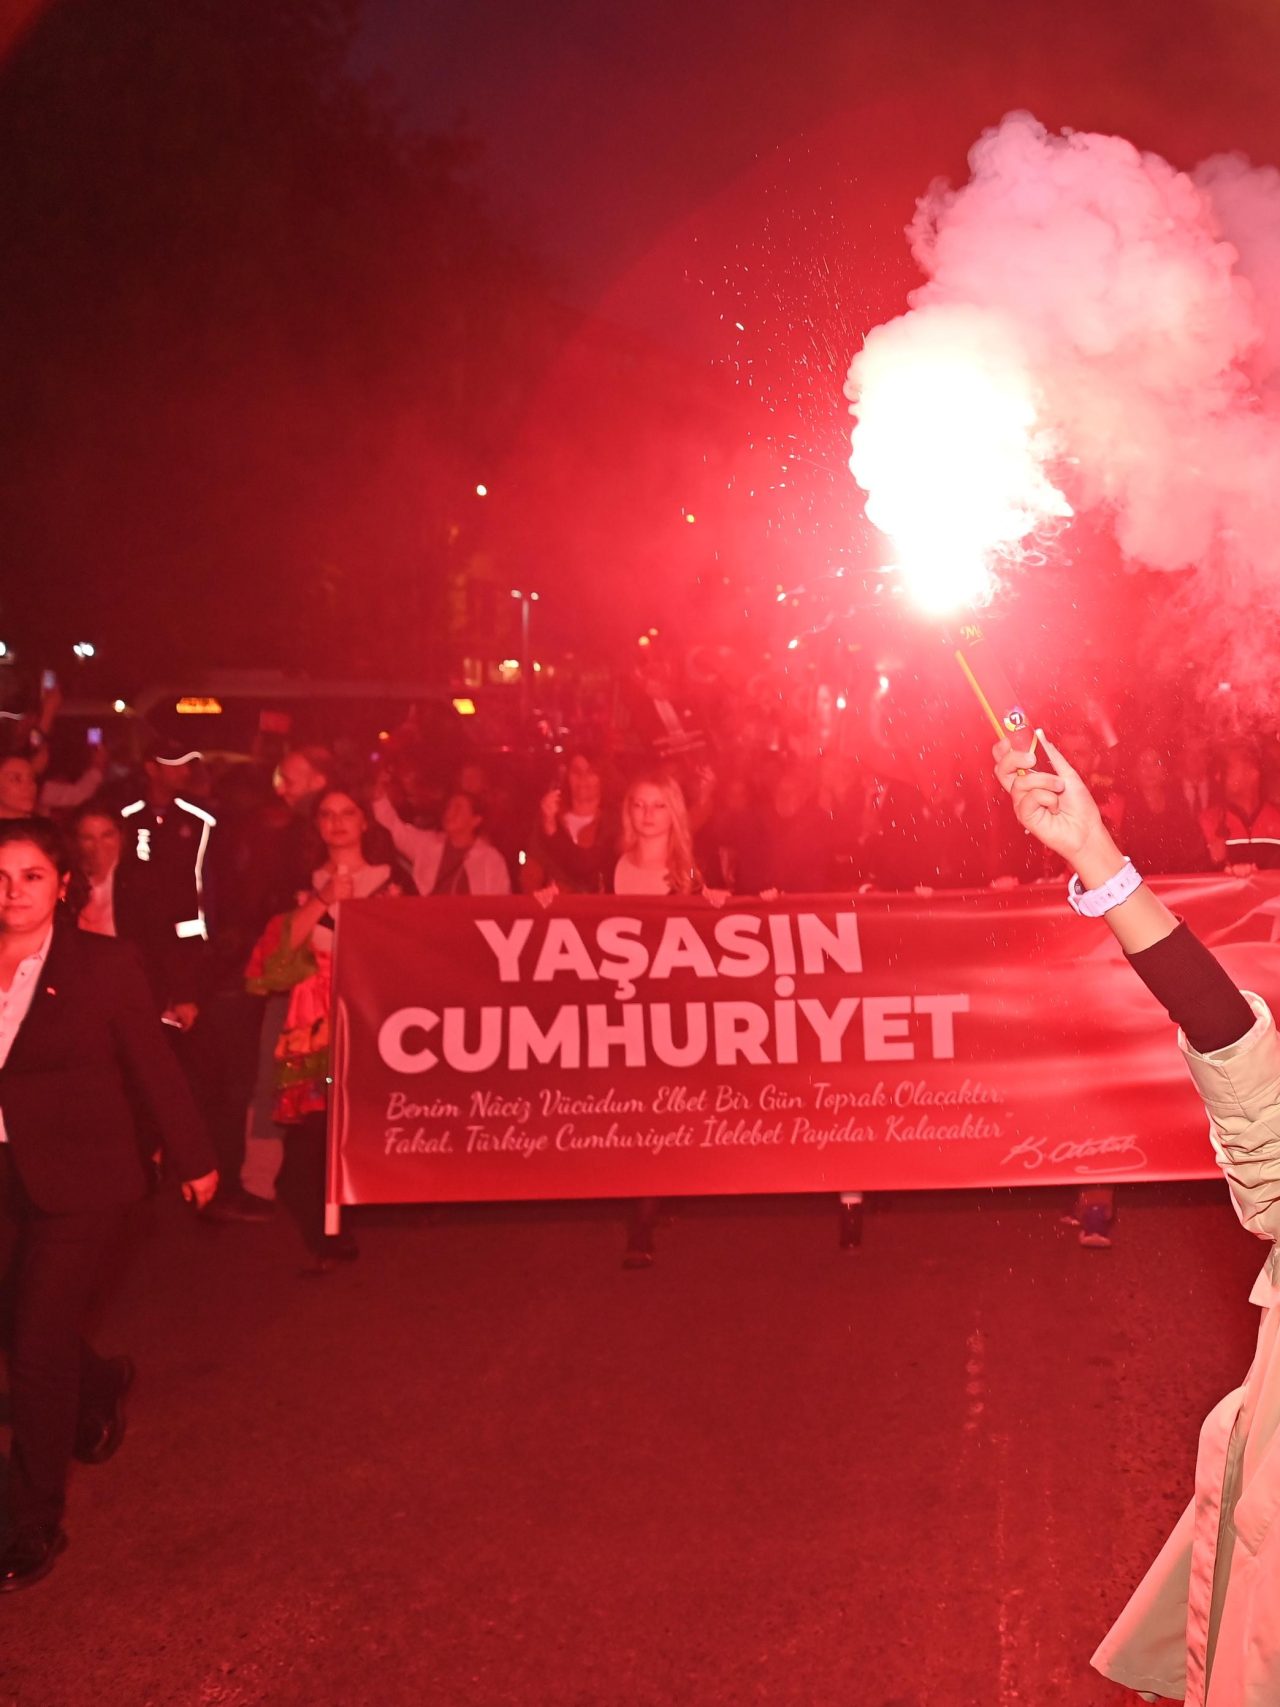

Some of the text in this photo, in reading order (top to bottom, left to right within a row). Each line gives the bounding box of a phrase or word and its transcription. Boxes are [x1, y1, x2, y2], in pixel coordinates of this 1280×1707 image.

[475, 912, 863, 1000] YAŞASIN
[378, 975, 970, 1074] CUMHURİYET
[386, 1091, 461, 1121] Benim
[652, 1085, 707, 1114] Elbet
[716, 1084, 750, 1112] Bir
[759, 1083, 803, 1111] Gün
[813, 1082, 884, 1115] Toprak
[466, 1124, 550, 1158] Türkiye
[555, 1122, 695, 1155] Cumhuriyeti
[700, 1115, 782, 1147] İlelebet
[789, 1116, 876, 1150] Payidar
